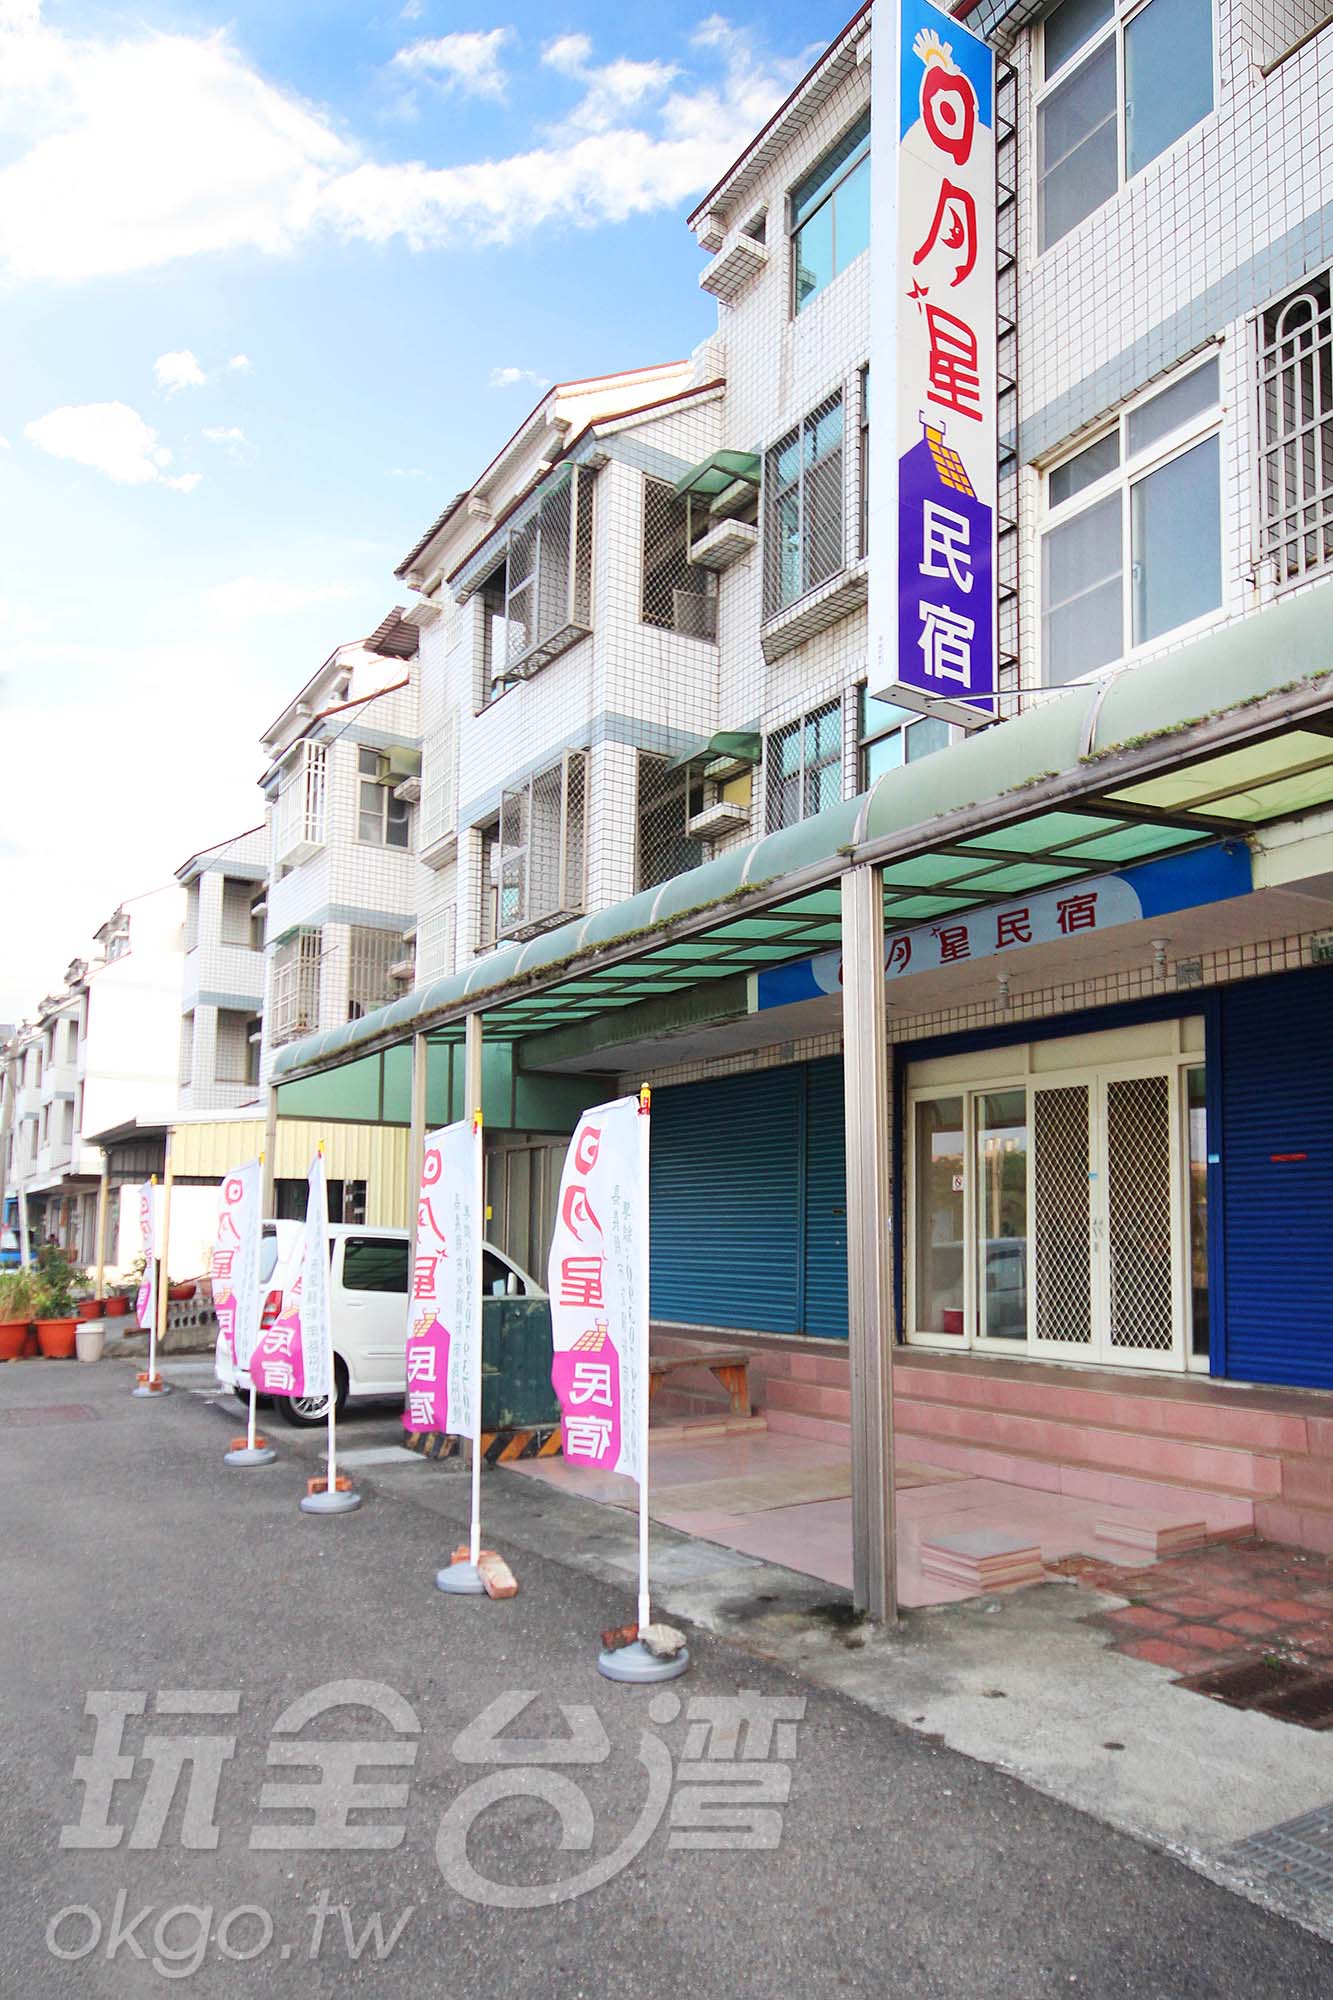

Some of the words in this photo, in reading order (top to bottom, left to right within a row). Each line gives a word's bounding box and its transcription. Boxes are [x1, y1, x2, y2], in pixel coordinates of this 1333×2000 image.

[906, 64, 982, 689] 日月星民宿
[838, 892, 1098, 985] 月星民宿
